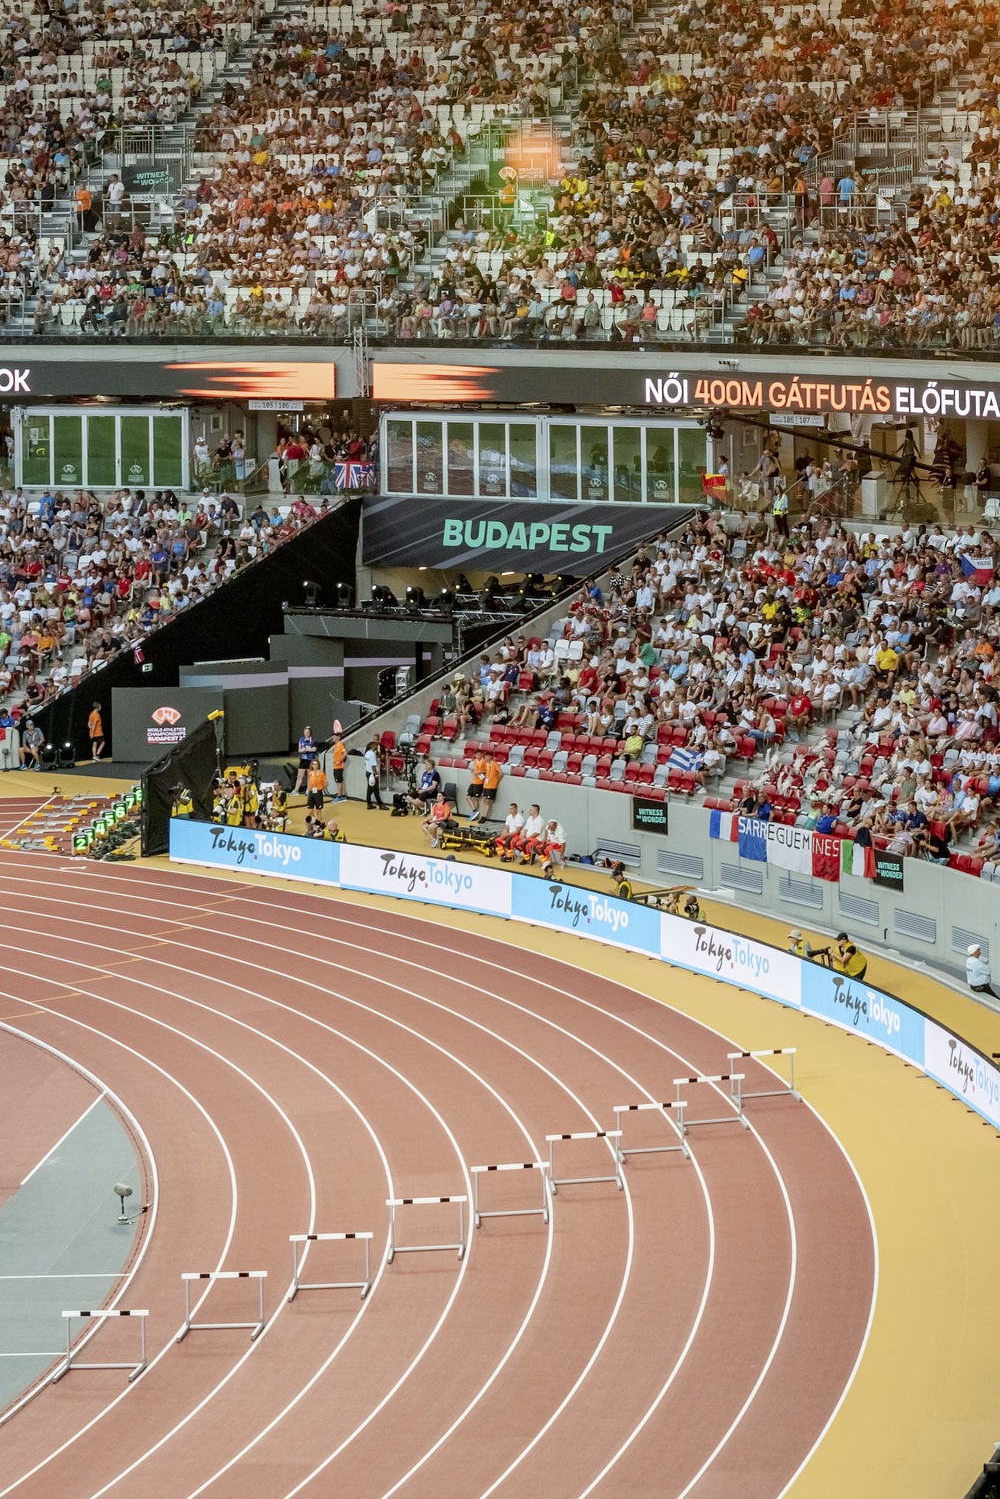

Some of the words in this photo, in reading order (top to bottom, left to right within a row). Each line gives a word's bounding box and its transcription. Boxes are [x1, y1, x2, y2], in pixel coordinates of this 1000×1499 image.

[645, 372, 688, 404] NŐI
[694, 379, 763, 407] 400M
[768, 376, 891, 413] GÁTFUTÁS
[442, 518, 613, 553] BUDAPEST
[115, 807, 126, 818] 6
[126, 797, 135, 809] 7
[638, 808, 663, 816] WITNESS
[95, 823, 105, 835] 4
[105, 814, 114, 827] 5
[641, 815, 667, 824] WONDER
[76, 838, 86, 851] 2
[209, 827, 255, 864] Tokyo
[254, 833, 301, 865] Tokyo
[738, 817, 840, 858] SARREGUEMINES
[380, 853, 426, 892] Tokyo
[426, 861, 473, 894] Tokyo
[877, 861, 900, 871] WITNESS
[880, 870, 903, 880] WONDER
[549, 885, 588, 927] Tokyo
[588, 895, 629, 932] Tokyo
[693, 927, 732, 971] Tokyo
[732, 939, 770, 978] Tokyo
[832, 977, 868, 1026] Tokyo
[866, 991, 901, 1035] Tokyo
[948, 1039, 974, 1093] Tokyo
[974, 1057, 1000, 1105] Tokyo
